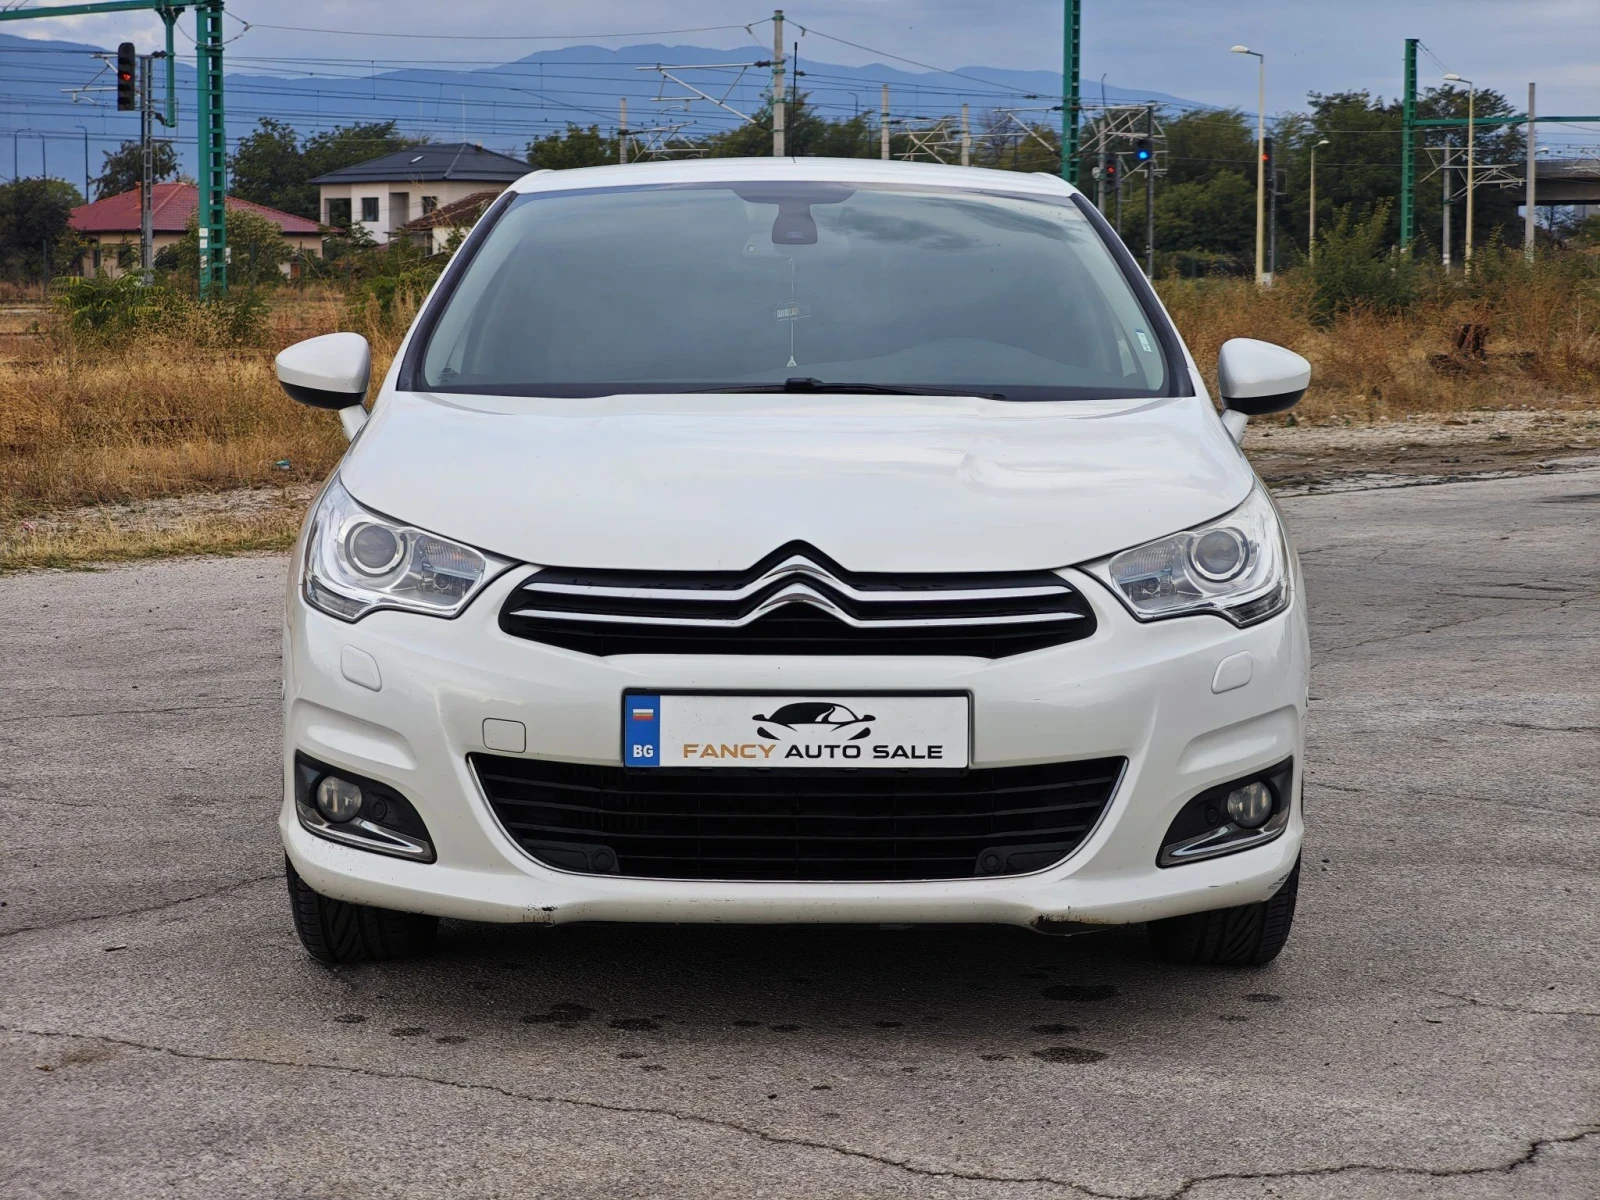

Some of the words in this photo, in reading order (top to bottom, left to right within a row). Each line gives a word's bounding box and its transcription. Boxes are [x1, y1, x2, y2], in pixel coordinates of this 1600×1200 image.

[633, 744, 654, 758] BG
[683, 743, 777, 759] FANCY
[784, 744, 862, 759] AUTO
[872, 744, 944, 760] SALE
